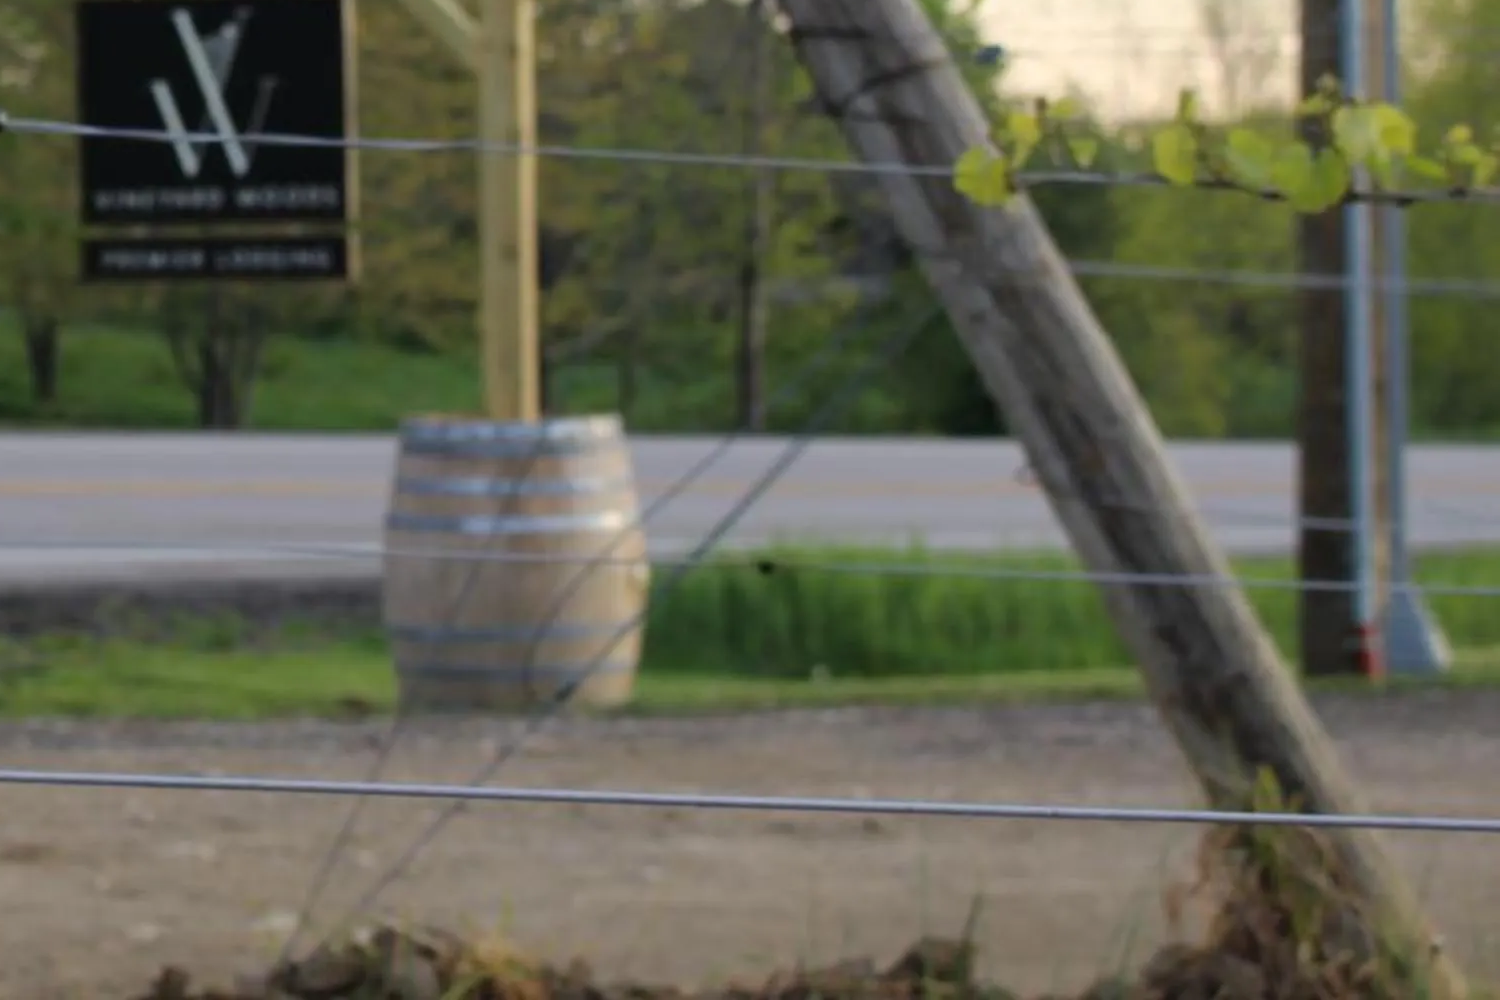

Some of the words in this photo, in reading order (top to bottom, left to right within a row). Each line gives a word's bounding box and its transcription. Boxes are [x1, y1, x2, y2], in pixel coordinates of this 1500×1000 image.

[94, 188, 224, 210] VINEYARD
[236, 185, 338, 208] WOODS
[215, 247, 331, 269] LODGING
